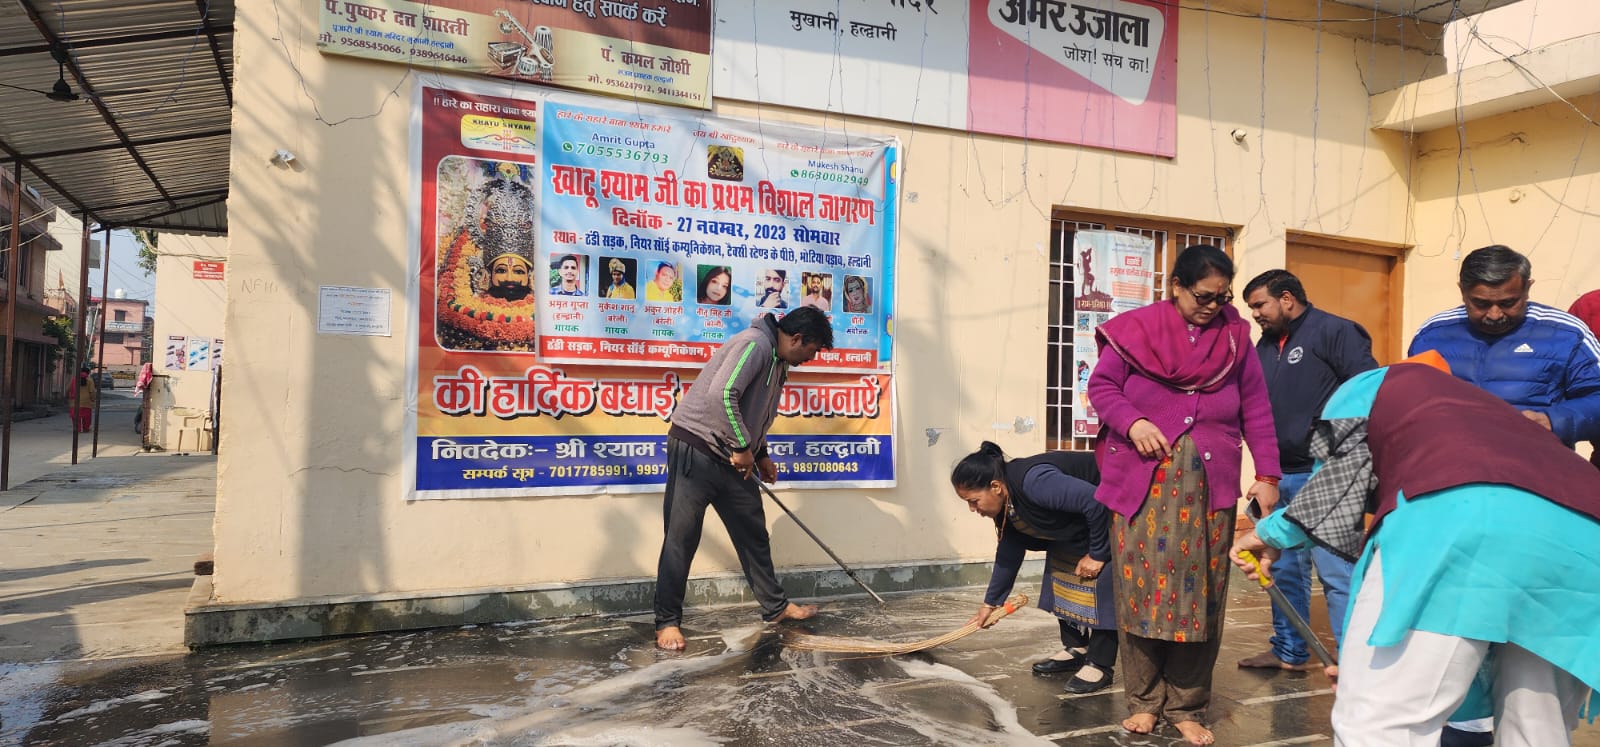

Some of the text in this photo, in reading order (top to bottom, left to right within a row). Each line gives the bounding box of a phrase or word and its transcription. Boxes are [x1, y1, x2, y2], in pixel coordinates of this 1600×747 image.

[393, 10, 418, 28] दत्त
[422, 15, 470, 36] शास्त्री
[642, 7, 668, 26] करें
[789, 10, 897, 41] मुखानी, हल्द्वानी
[998, 0, 1150, 48] अमर उजाला
[622, 51, 655, 69] कमल
[660, 55, 691, 75] जोशी
[1063, 43, 1149, 73] जोश! सच का!
[459, 100, 472, 110] का
[522, 109, 536, 118] श्या
[503, 122, 531, 131] SHYAM
[592, 133, 655, 150] Amrit Gupta
[576, 143, 669, 165] 7055536793
[808, 160, 864, 174] Mukesh Shanu
[551, 165, 874, 225] खाटू श्याम जी का प्रथम विशाल जागरण
[677, 217, 692, 232] 27
[696, 219, 749, 240] नवम्बर,
[754, 224, 786, 241] 2023
[793, 225, 840, 246] सोमवार
[630, 234, 652, 250] नियर
[770, 247, 778, 260] के
[600, 340, 624, 353] नियर
[434, 366, 881, 420] की हार्दिक बधाई कामनाऐं
[555, 441, 586, 459] श्री
[593, 442, 656, 459] श्याम
[806, 438, 882, 458] हल्द्वानी
[463, 465, 508, 480] सम्पर्क
[512, 467, 535, 482] सूत्र
[549, 464, 633, 479] 7017785991,
[793, 461, 858, 474] 9897080643
